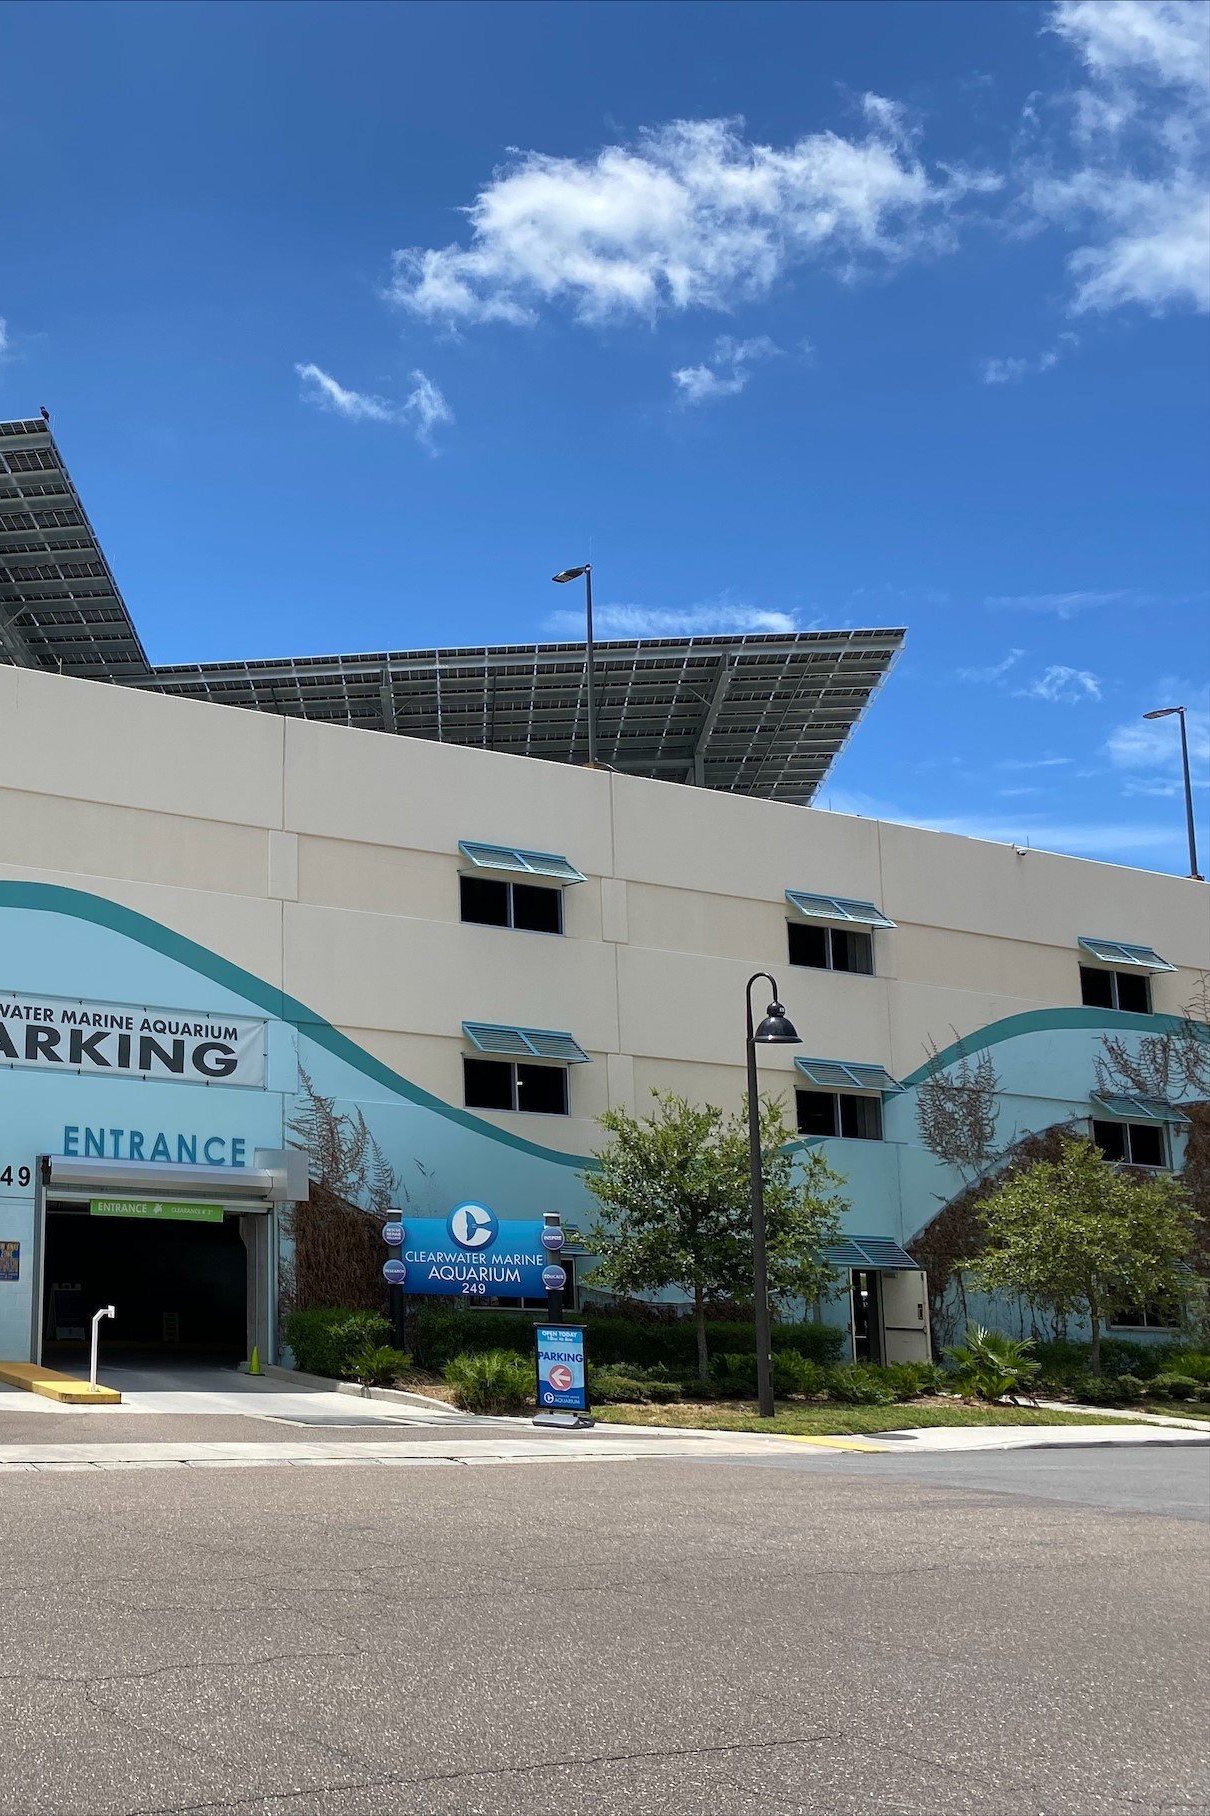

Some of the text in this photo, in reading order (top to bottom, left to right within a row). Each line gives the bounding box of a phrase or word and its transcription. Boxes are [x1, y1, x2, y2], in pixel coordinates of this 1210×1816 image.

[61, 1010, 134, 1031] MARINE
[139, 1018, 238, 1041] AQUARIUM
[63, 1125, 246, 1168] ENTRANCE
[97, 1201, 148, 1214] ENTRANCE
[405, 1250, 544, 1266] CLEARWATER MARINE
[428, 1265, 521, 1282] AQUARIUM
[461, 1282, 486, 1294] 249
[539, 1352, 583, 1362] PARKING
